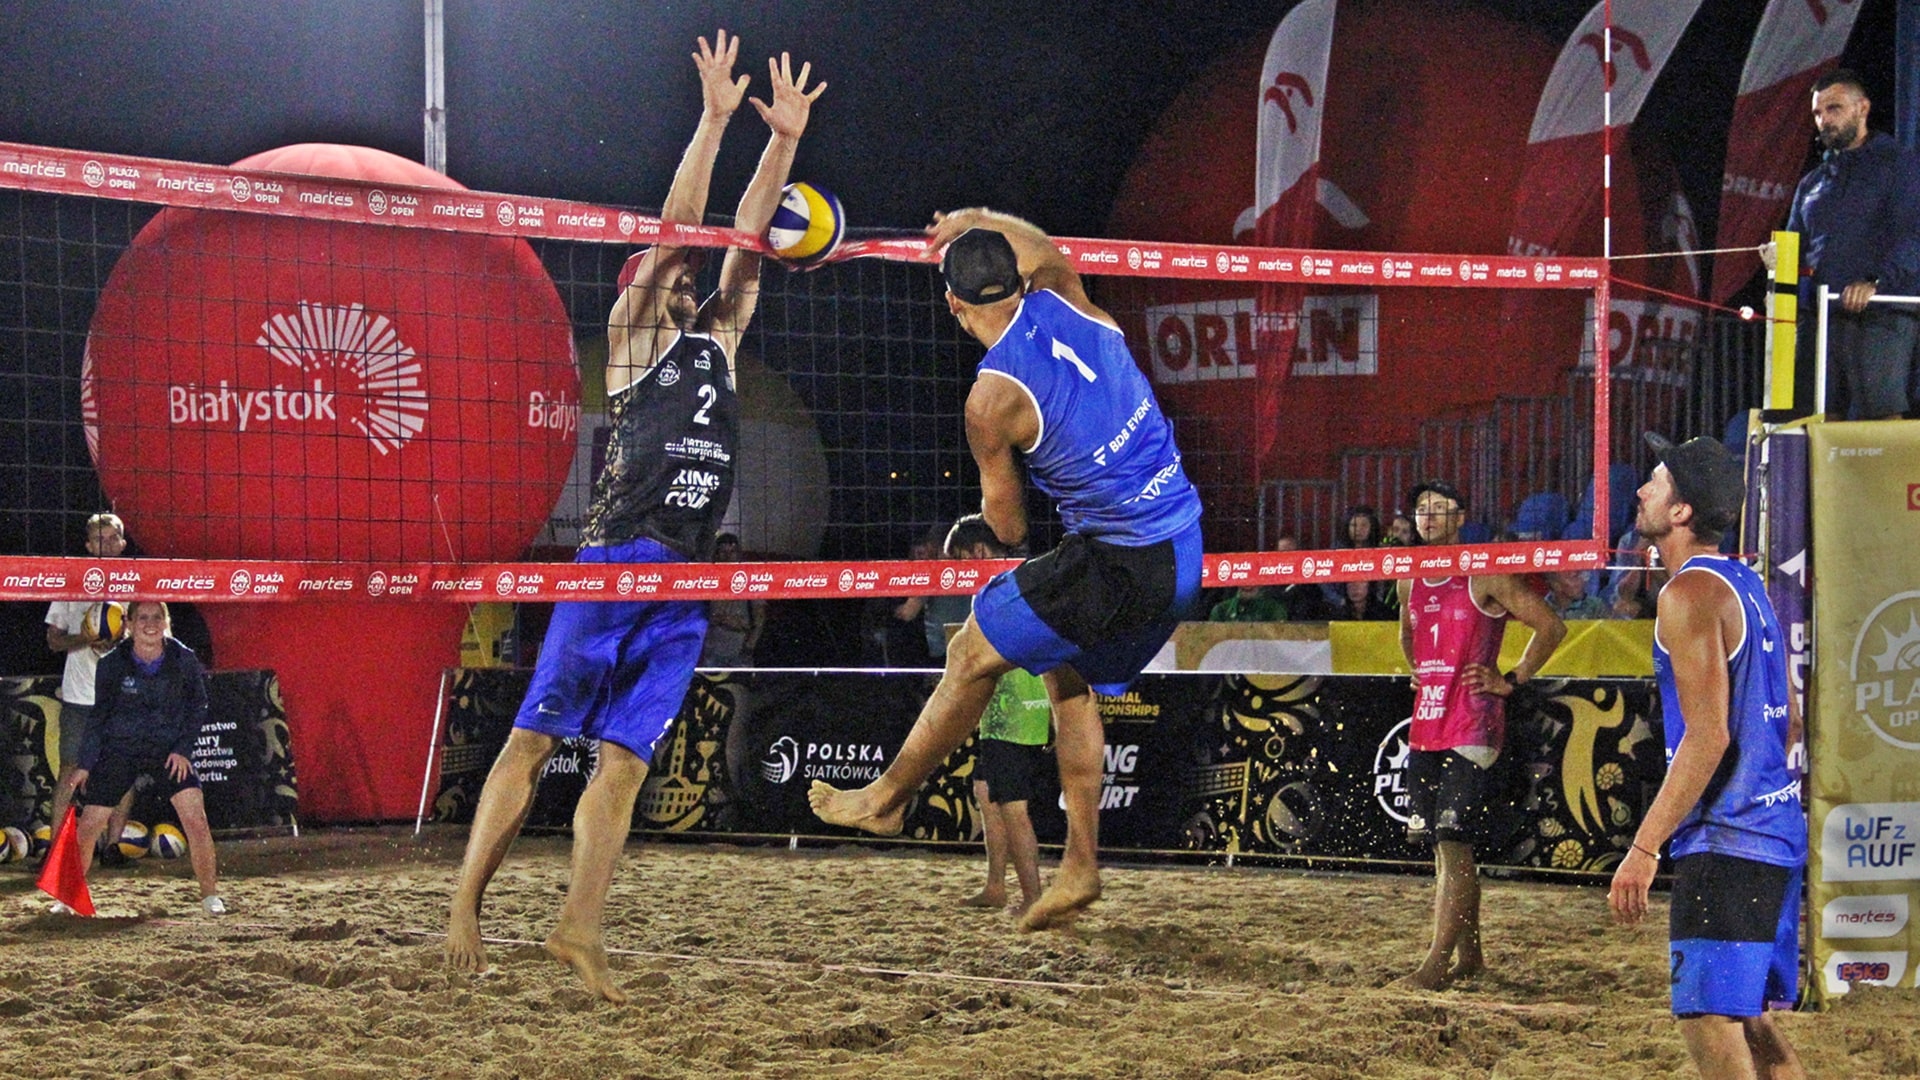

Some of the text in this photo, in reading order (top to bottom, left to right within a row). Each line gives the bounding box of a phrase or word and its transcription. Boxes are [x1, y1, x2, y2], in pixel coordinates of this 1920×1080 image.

[4, 160, 66, 178] martes
[109, 180, 135, 190] OPEN
[157, 176, 215, 193] martes
[255, 194, 280, 204] OPEN
[300, 191, 354, 207] martes
[391, 206, 414, 217] OPEN
[433, 203, 484, 218] martes
[518, 217, 541, 227] OPEN
[557, 213, 606, 227] martes
[1081, 250, 1119, 264] martes
[1172, 255, 1208, 268] martes
[1258, 259, 1293, 272] martes
[1341, 261, 1374, 274] martes
[1421, 264, 1452, 276] martes
[1497, 266, 1527, 278] martes
[1569, 268, 1598, 279] martes
[1157, 307, 1360, 371] ORLN
[1052, 337, 1098, 383] 1
[168, 378, 337, 432] Białystok
[692, 384, 718, 426] 2
[1108, 428, 1131, 454] BDB
[1126, 397, 1153, 432] EVENT
[1420, 557, 1452, 569] martes
[1496, 554, 1526, 565] martes
[1568, 551, 1598, 562] martes
[1259, 563, 1294, 576] martes
[1341, 560, 1375, 573] martes
[3, 573, 67, 588] martes
[156, 575, 215, 589] martes
[298, 576, 354, 591] martes
[431, 577, 483, 590] martes
[556, 577, 605, 590] martes
[673, 576, 719, 589] martes
[784, 574, 828, 588] martes
[855, 581, 875, 590] OPEN
[889, 572, 930, 586] martes
[956, 579, 975, 588] OPEN
[108, 583, 135, 593] OPEN
[254, 584, 279, 594] OPEN
[389, 585, 413, 595] OPEN
[516, 585, 539, 594] OPEN
[636, 584, 657, 593] OPEN
[749, 583, 769, 592] OPEN
[1429, 622, 1439, 650] 1
[806, 742, 884, 762] POLSKA
[803, 762, 882, 780] SIATKÓWKA
[1836, 911, 1896, 924] martes
